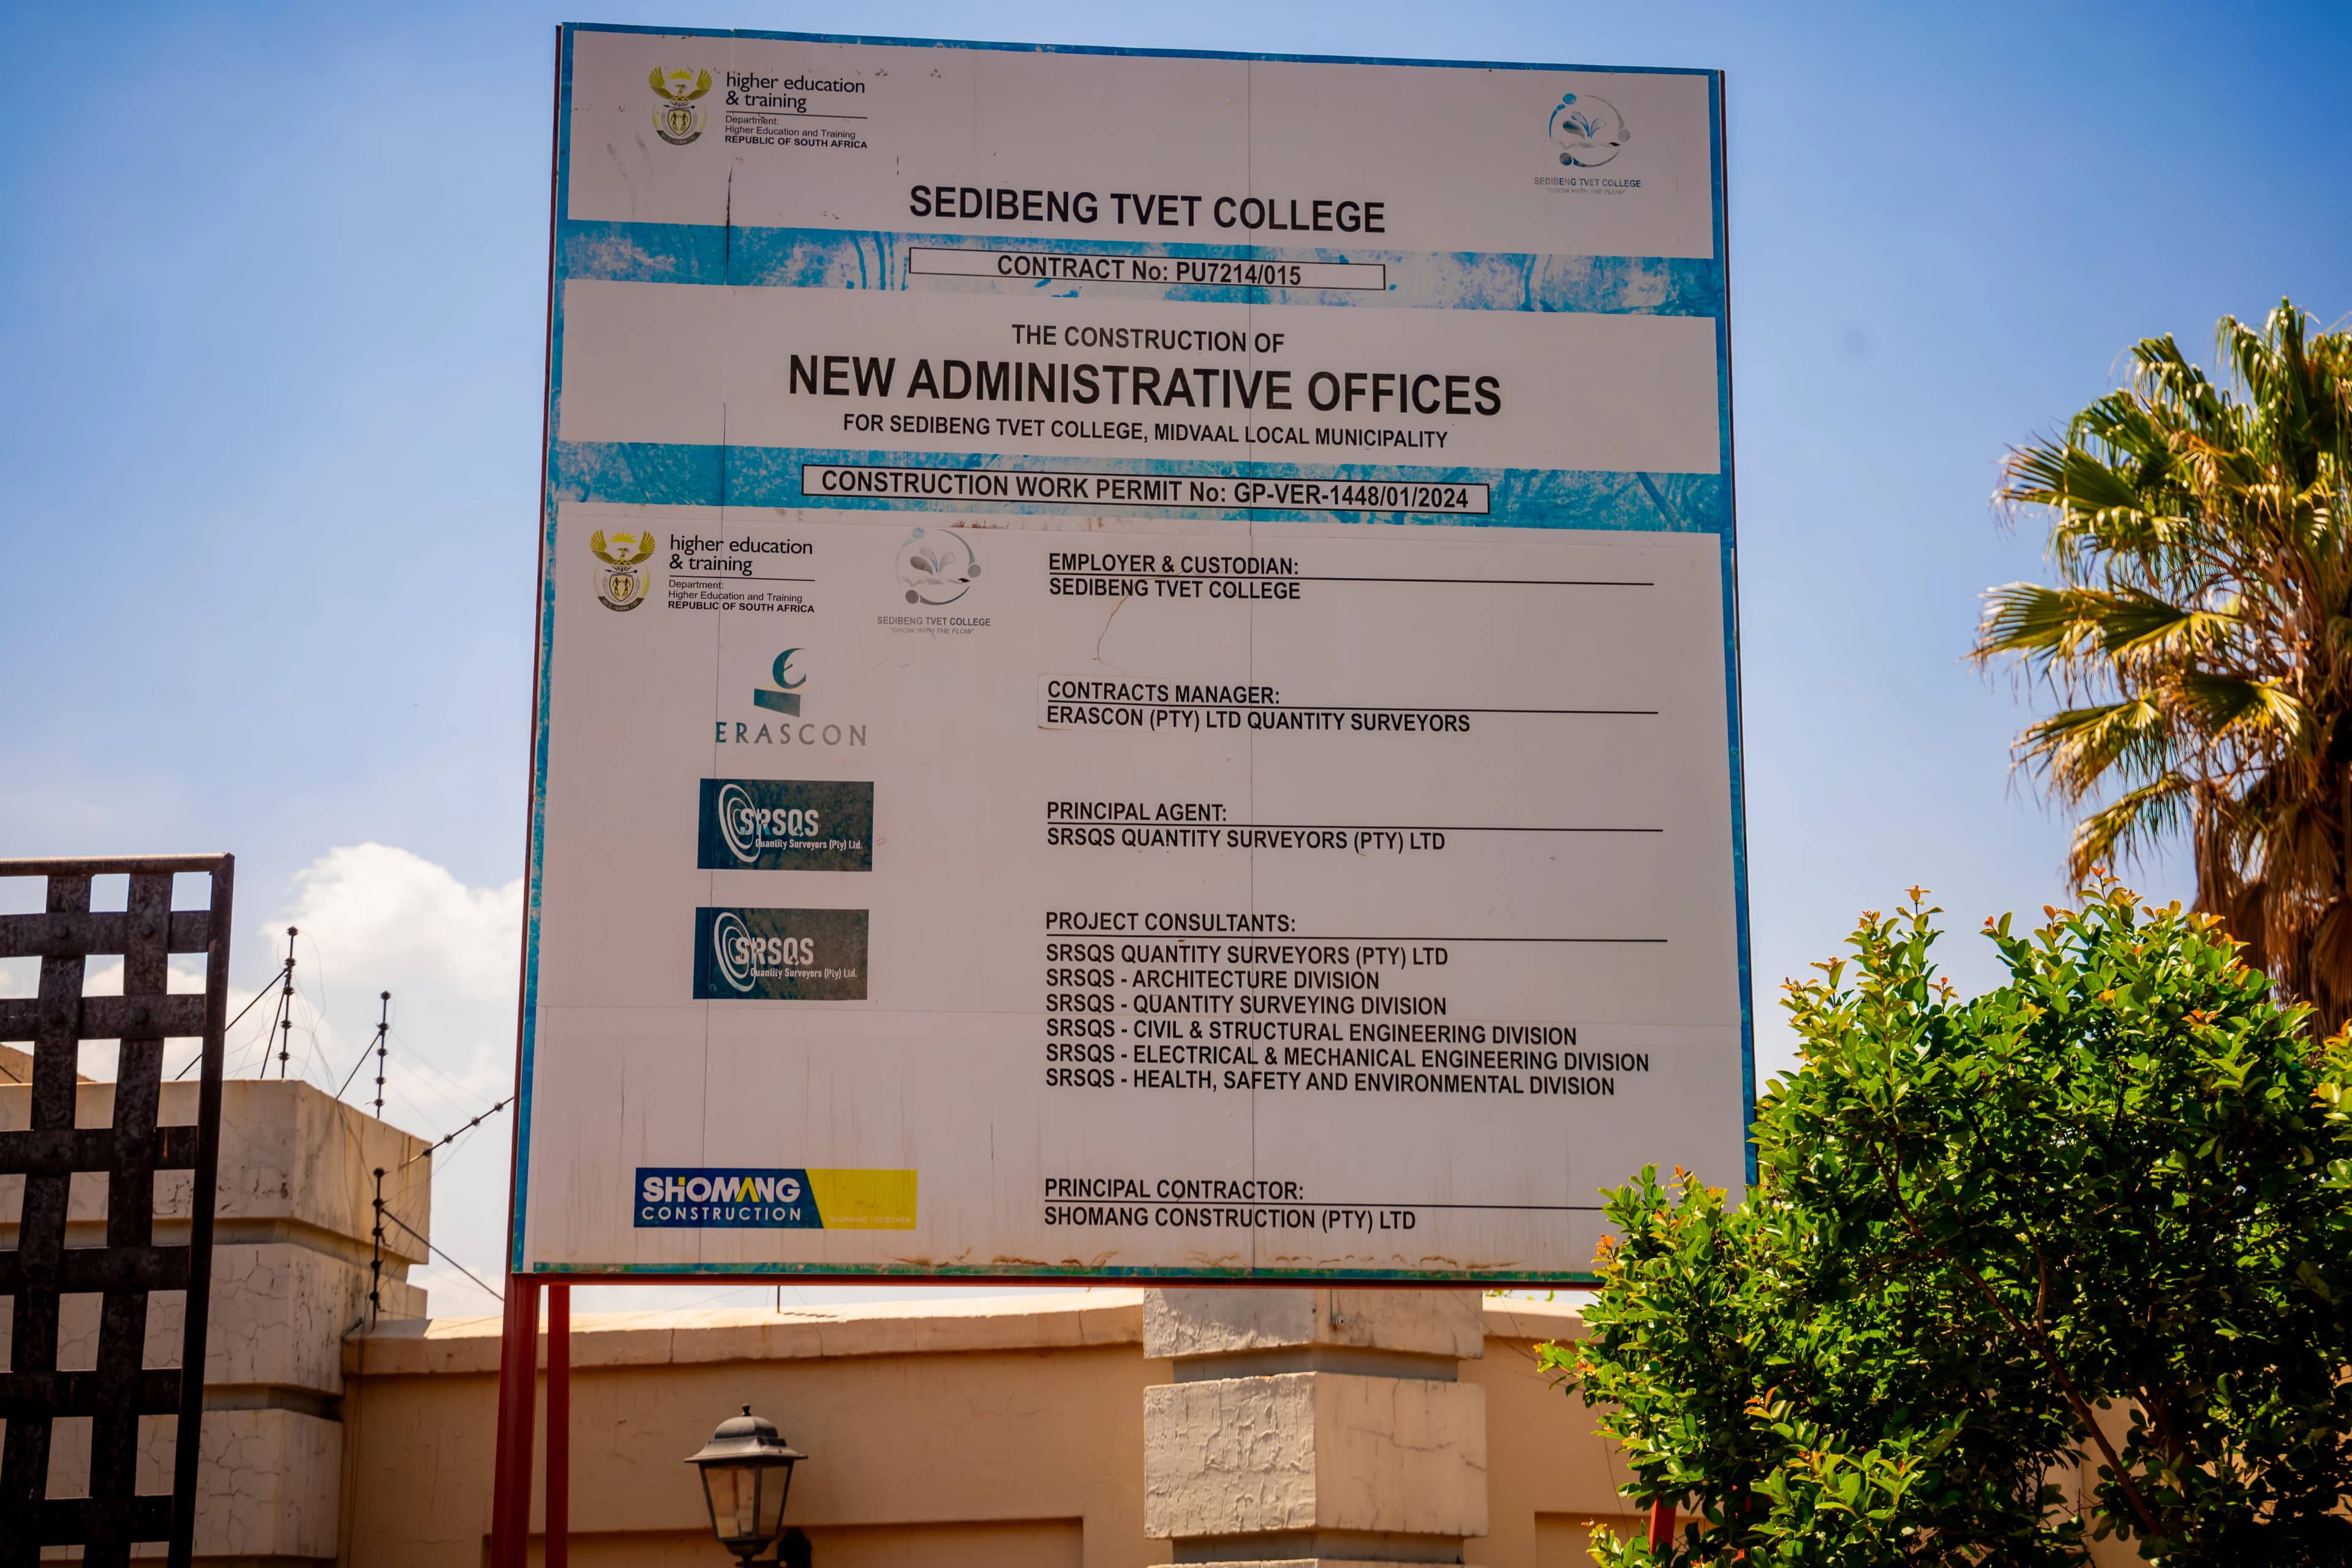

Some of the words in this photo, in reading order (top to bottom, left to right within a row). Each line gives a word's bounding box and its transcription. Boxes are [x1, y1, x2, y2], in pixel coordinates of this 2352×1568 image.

[726, 71, 778, 91] higher
[783, 75, 866, 94] education
[726, 90, 739, 105] &
[745, 92, 807, 113] training
[726, 116, 779, 125] Department:
[725, 126, 754, 135] Higher
[756, 127, 799, 136] Education
[821, 129, 856, 140] Training
[725, 135, 774, 145] REPUBLIC
[794, 138, 827, 147] SOUTH
[831, 140, 867, 149] AFRICA
[1534, 177, 1577, 186] SEDIBENG
[1602, 179, 1641, 187] COLLEGE
[910, 185, 1098, 224] SEDIBENG
[1110, 193, 1202, 227] TVET
[1214, 197, 1385, 233] COLLEGE
[997, 254, 1125, 280] CONTRACT
[1133, 258, 1169, 281] No:
[1177, 261, 1302, 286] PU7214/015
[1012, 324, 1057, 345] THE
[1065, 326, 1246, 353] CONSTRUCTION
[1254, 333, 1285, 353] OF
[790, 354, 895, 397] NEW
[907, 359, 1292, 409] ADMINISTRATIVE
[1308, 371, 1501, 415] OFFICES
[843, 413, 883, 431] FOR
[890, 415, 990, 435] SEDIBENG
[996, 418, 1045, 436] TVET
[1051, 420, 1148, 443] COLLEGE,
[1154, 424, 1240, 442] MIDVAAL
[1245, 426, 1310, 445] LOCAL
[1316, 428, 1448, 448] MUNICIPALITY
[822, 470, 1008, 496] CONSTRUCTION
[1016, 476, 1089, 499] WORK
[1096, 479, 1182, 501] PERMIT
[1189, 481, 1226, 502] No:
[1234, 482, 1469, 508] GP-VER-1448/01/2024
[670, 534, 724, 555] higher
[729, 538, 813, 555] education
[669, 555, 684, 570] &
[688, 555, 753, 576] training
[1049, 553, 1155, 572] EMPLOYER
[1161, 556, 1175, 573] &
[1180, 556, 1299, 575] CUSTODIAN:
[669, 580, 724, 589] Department:
[1049, 578, 1149, 597] SEDIBENG
[1154, 579, 1202, 597] TVET
[1208, 580, 1301, 599] COLLEGE
[668, 601, 719, 610] REPUBLIC
[722, 602, 736, 611] OF
[739, 603, 774, 611] SOUTH
[777, 605, 814, 613] AFRICA
[669, 590, 698, 600] Higher
[701, 591, 744, 600] Education
[767, 594, 802, 603] Training
[877, 616, 922, 625] SEDIBENG
[925, 617, 948, 625] TVET
[950, 617, 991, 626] COLLEGE
[1047, 680, 1169, 701] CONTRACTS
[1175, 685, 1280, 704] MANAGER:
[1047, 706, 1143, 726] ERASCON
[1150, 709, 1200, 732] (PTY)
[1207, 710, 1241, 728] LTD
[1247, 711, 1345, 731] QUANTITY
[1350, 714, 1470, 732] SURVEYORS
[716, 722, 866, 746] ERASCON
[1047, 802, 1150, 821] PRINCIPAL
[1155, 804, 1227, 821] AGENT:
[740, 809, 819, 837] SRSQS
[755, 839, 787, 850] Quantity
[790, 839, 827, 850] Surveyors
[829, 840, 846, 851] (Pty)
[848, 840, 862, 850] Ltd.
[1047, 827, 1115, 848] SRSQS
[1121, 829, 1222, 849] QUANTITY
[1227, 830, 1348, 850] SURVEYORS
[1354, 832, 1404, 854] (PTY)
[1410, 832, 1446, 850] LTD
[1046, 912, 1138, 930] PROJECT
[1144, 913, 1296, 932] CONSULTANTS:
[735, 937, 814, 965] SRSQS
[1046, 944, 1115, 963] SRSQS
[1121, 944, 1221, 963] QUANTITY
[1227, 946, 1349, 964] SURVEYORS
[1356, 947, 1406, 970] (PTY)
[1412, 948, 1448, 965] LTD
[750, 968, 782, 979] Quantity
[785, 968, 822, 979] Surveyors
[824, 968, 841, 979] (Pty)
[843, 968, 858, 978] Ltd.
[1046, 968, 1115, 989] SRSQS
[1133, 970, 1287, 989] ARCHITECTURE
[1294, 971, 1379, 989] DIVISION
[1046, 993, 1115, 1013] SRSQS
[1133, 995, 1234, 1014] QUANTITY
[1240, 995, 1355, 1014] SURVEYING
[1362, 997, 1446, 1015] DIVISION
[1046, 1019, 1115, 1038] SRSQS
[1133, 1020, 1183, 1038] CIVIL
[1189, 1020, 1203, 1039] &
[1209, 1021, 1343, 1041] STRUCTURAL
[1350, 1024, 1485, 1043] ENGINEERING
[1492, 1027, 1577, 1045] DIVISION
[1046, 1043, 1115, 1063] SRSQS
[1134, 1045, 1259, 1065] ELECTRICAL
[1264, 1047, 1278, 1065] &
[1284, 1047, 1415, 1067] MECHANICAL
[1422, 1050, 1558, 1069] ENGINEERING
[1564, 1052, 1649, 1071] DIVISION
[1046, 1068, 1115, 1088] SRSQS
[1134, 1069, 1218, 1093] HEALTH,
[1224, 1071, 1301, 1090] SAFETY
[1306, 1072, 1348, 1090] AND
[1354, 1073, 1524, 1093] ENVIRONMENTAL
[1530, 1076, 1615, 1095] DIVISION
[643, 1177, 801, 1202] SHOMANG
[1044, 1178, 1150, 1197] PRINCIPAL
[1156, 1179, 1303, 1200] CONTRACTOR:
[642, 1206, 801, 1221] CONSTRUCTION
[1044, 1206, 1148, 1226] SHOMANG
[1155, 1208, 1315, 1228] CONSTRUCTION
[1322, 1210, 1373, 1234] (PTY)
[1379, 1211, 1415, 1229] LTD
